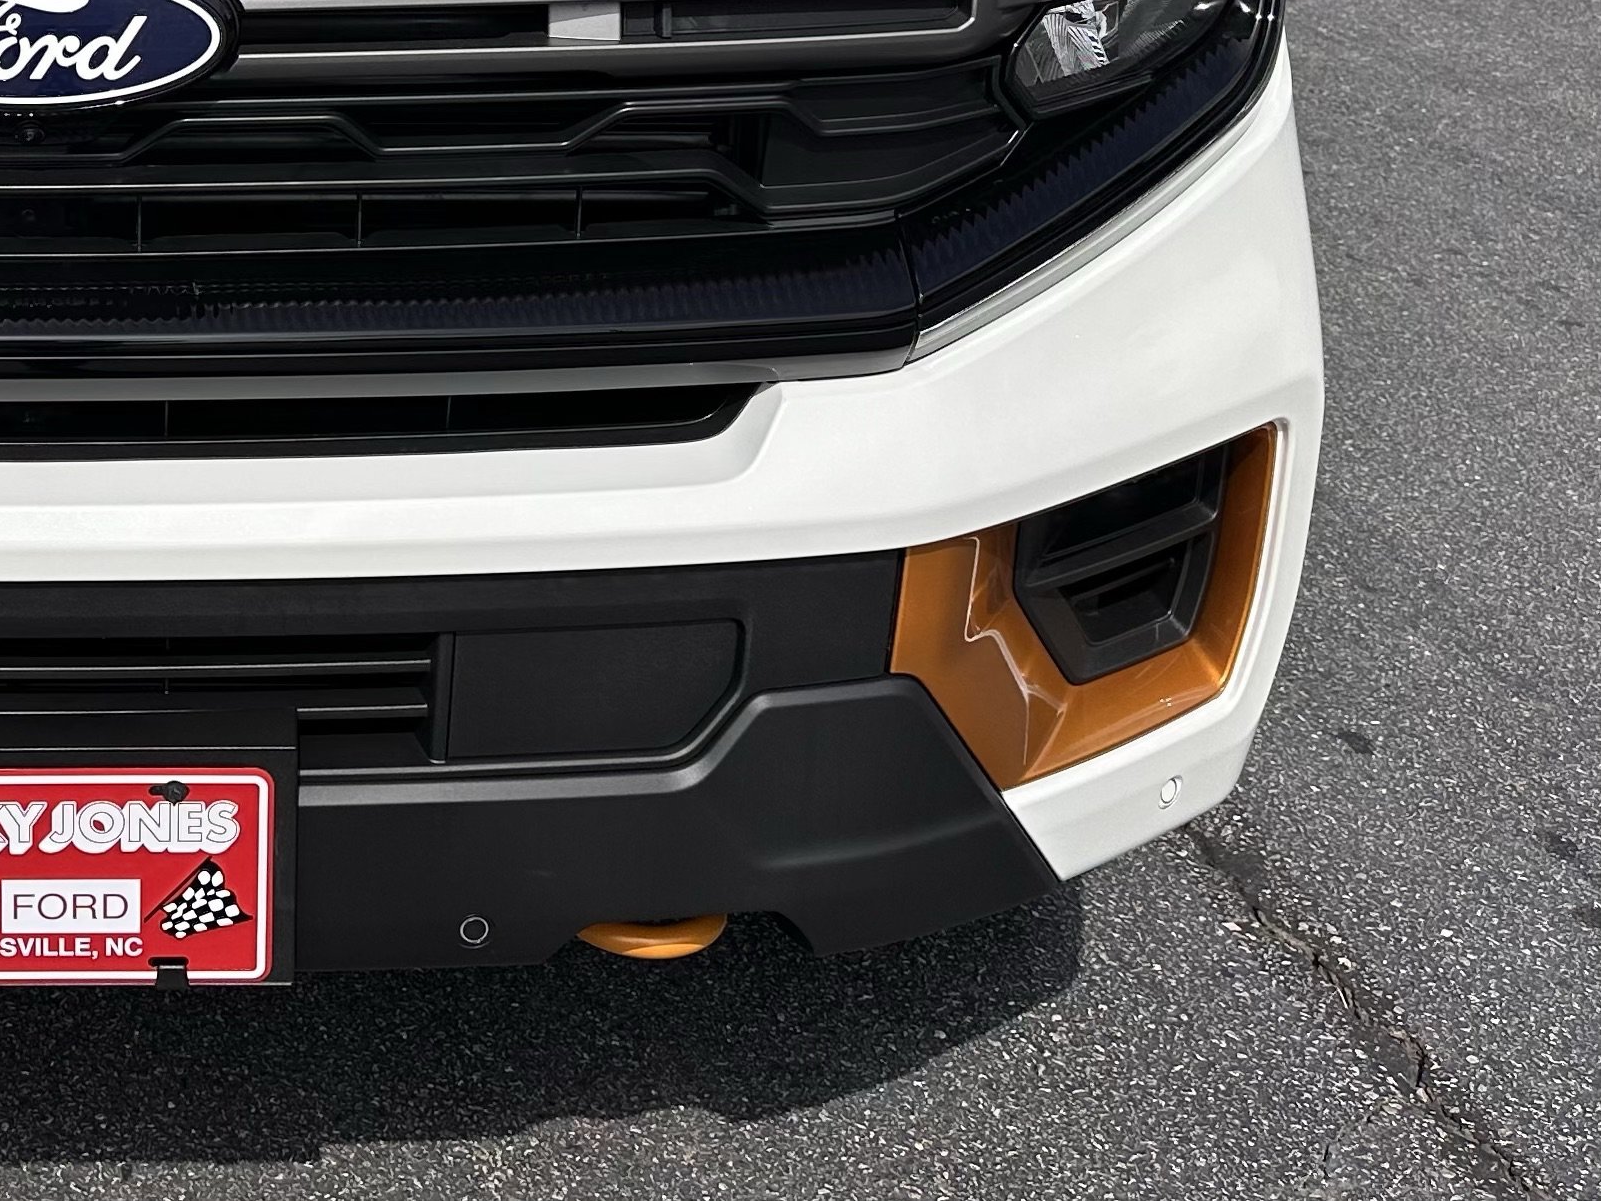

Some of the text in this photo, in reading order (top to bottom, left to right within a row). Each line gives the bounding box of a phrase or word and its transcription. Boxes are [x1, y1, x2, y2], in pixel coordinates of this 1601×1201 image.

[38, 800, 241, 854] JONES
[13, 893, 129, 920] FORD
[105, 937, 143, 957] NC
